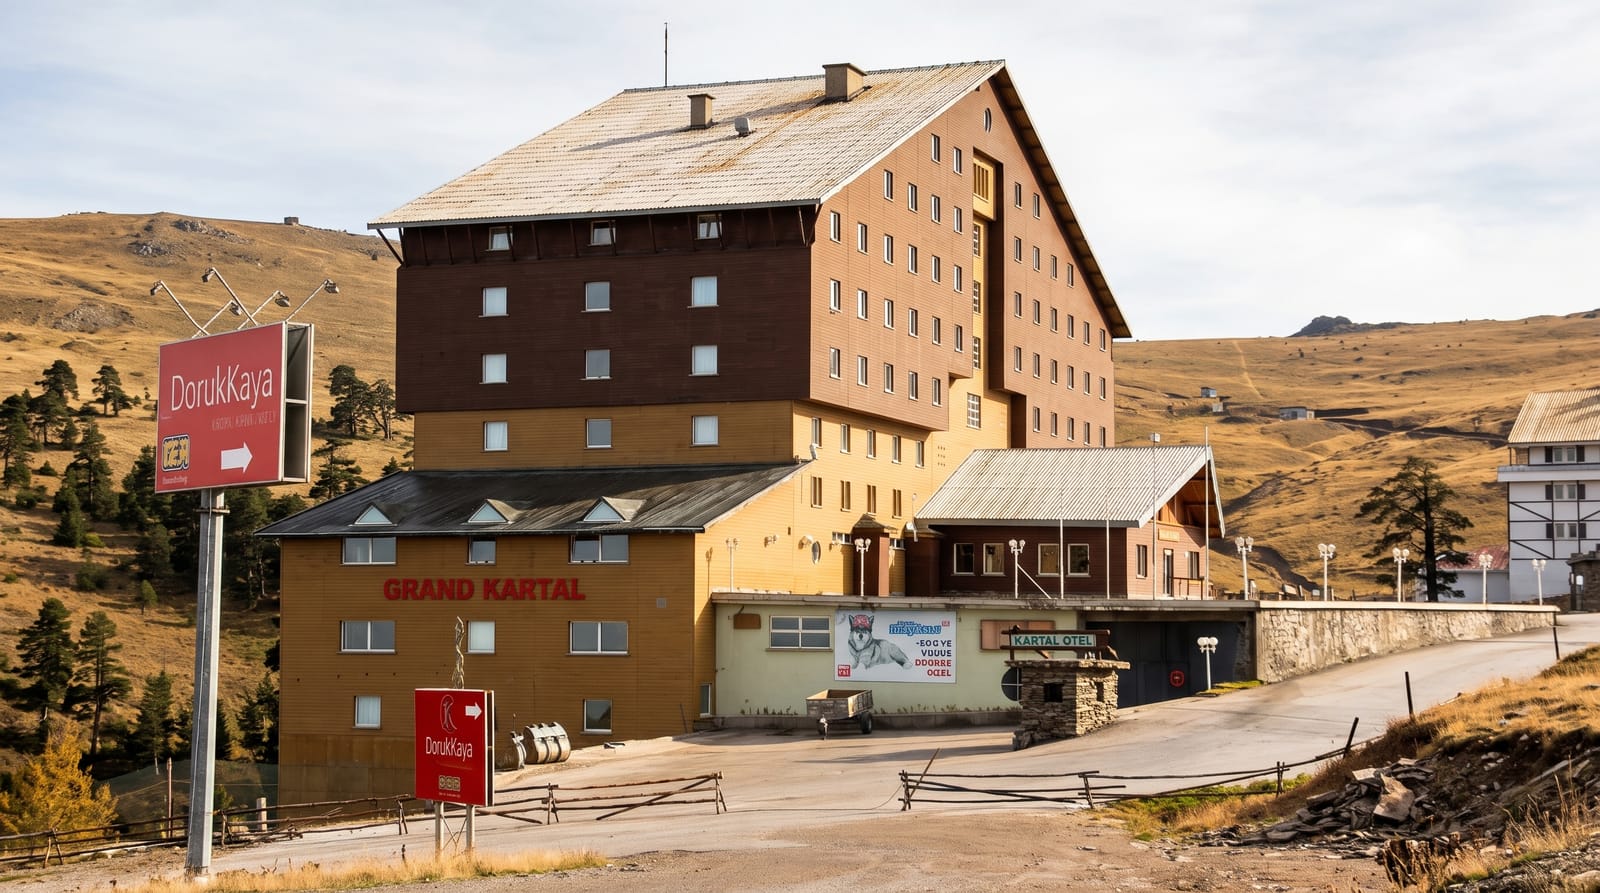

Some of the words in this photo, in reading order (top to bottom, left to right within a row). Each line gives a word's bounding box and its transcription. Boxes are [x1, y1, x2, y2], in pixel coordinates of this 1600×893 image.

[171, 364, 273, 411] DorukKaya
[383, 578, 475, 600] GRAND
[482, 578, 586, 600] KARTAL
[1014, 635, 1060, 645] KARTAL
[1062, 635, 1092, 645] OTEL
[425, 736, 473, 762] DorukKaya
